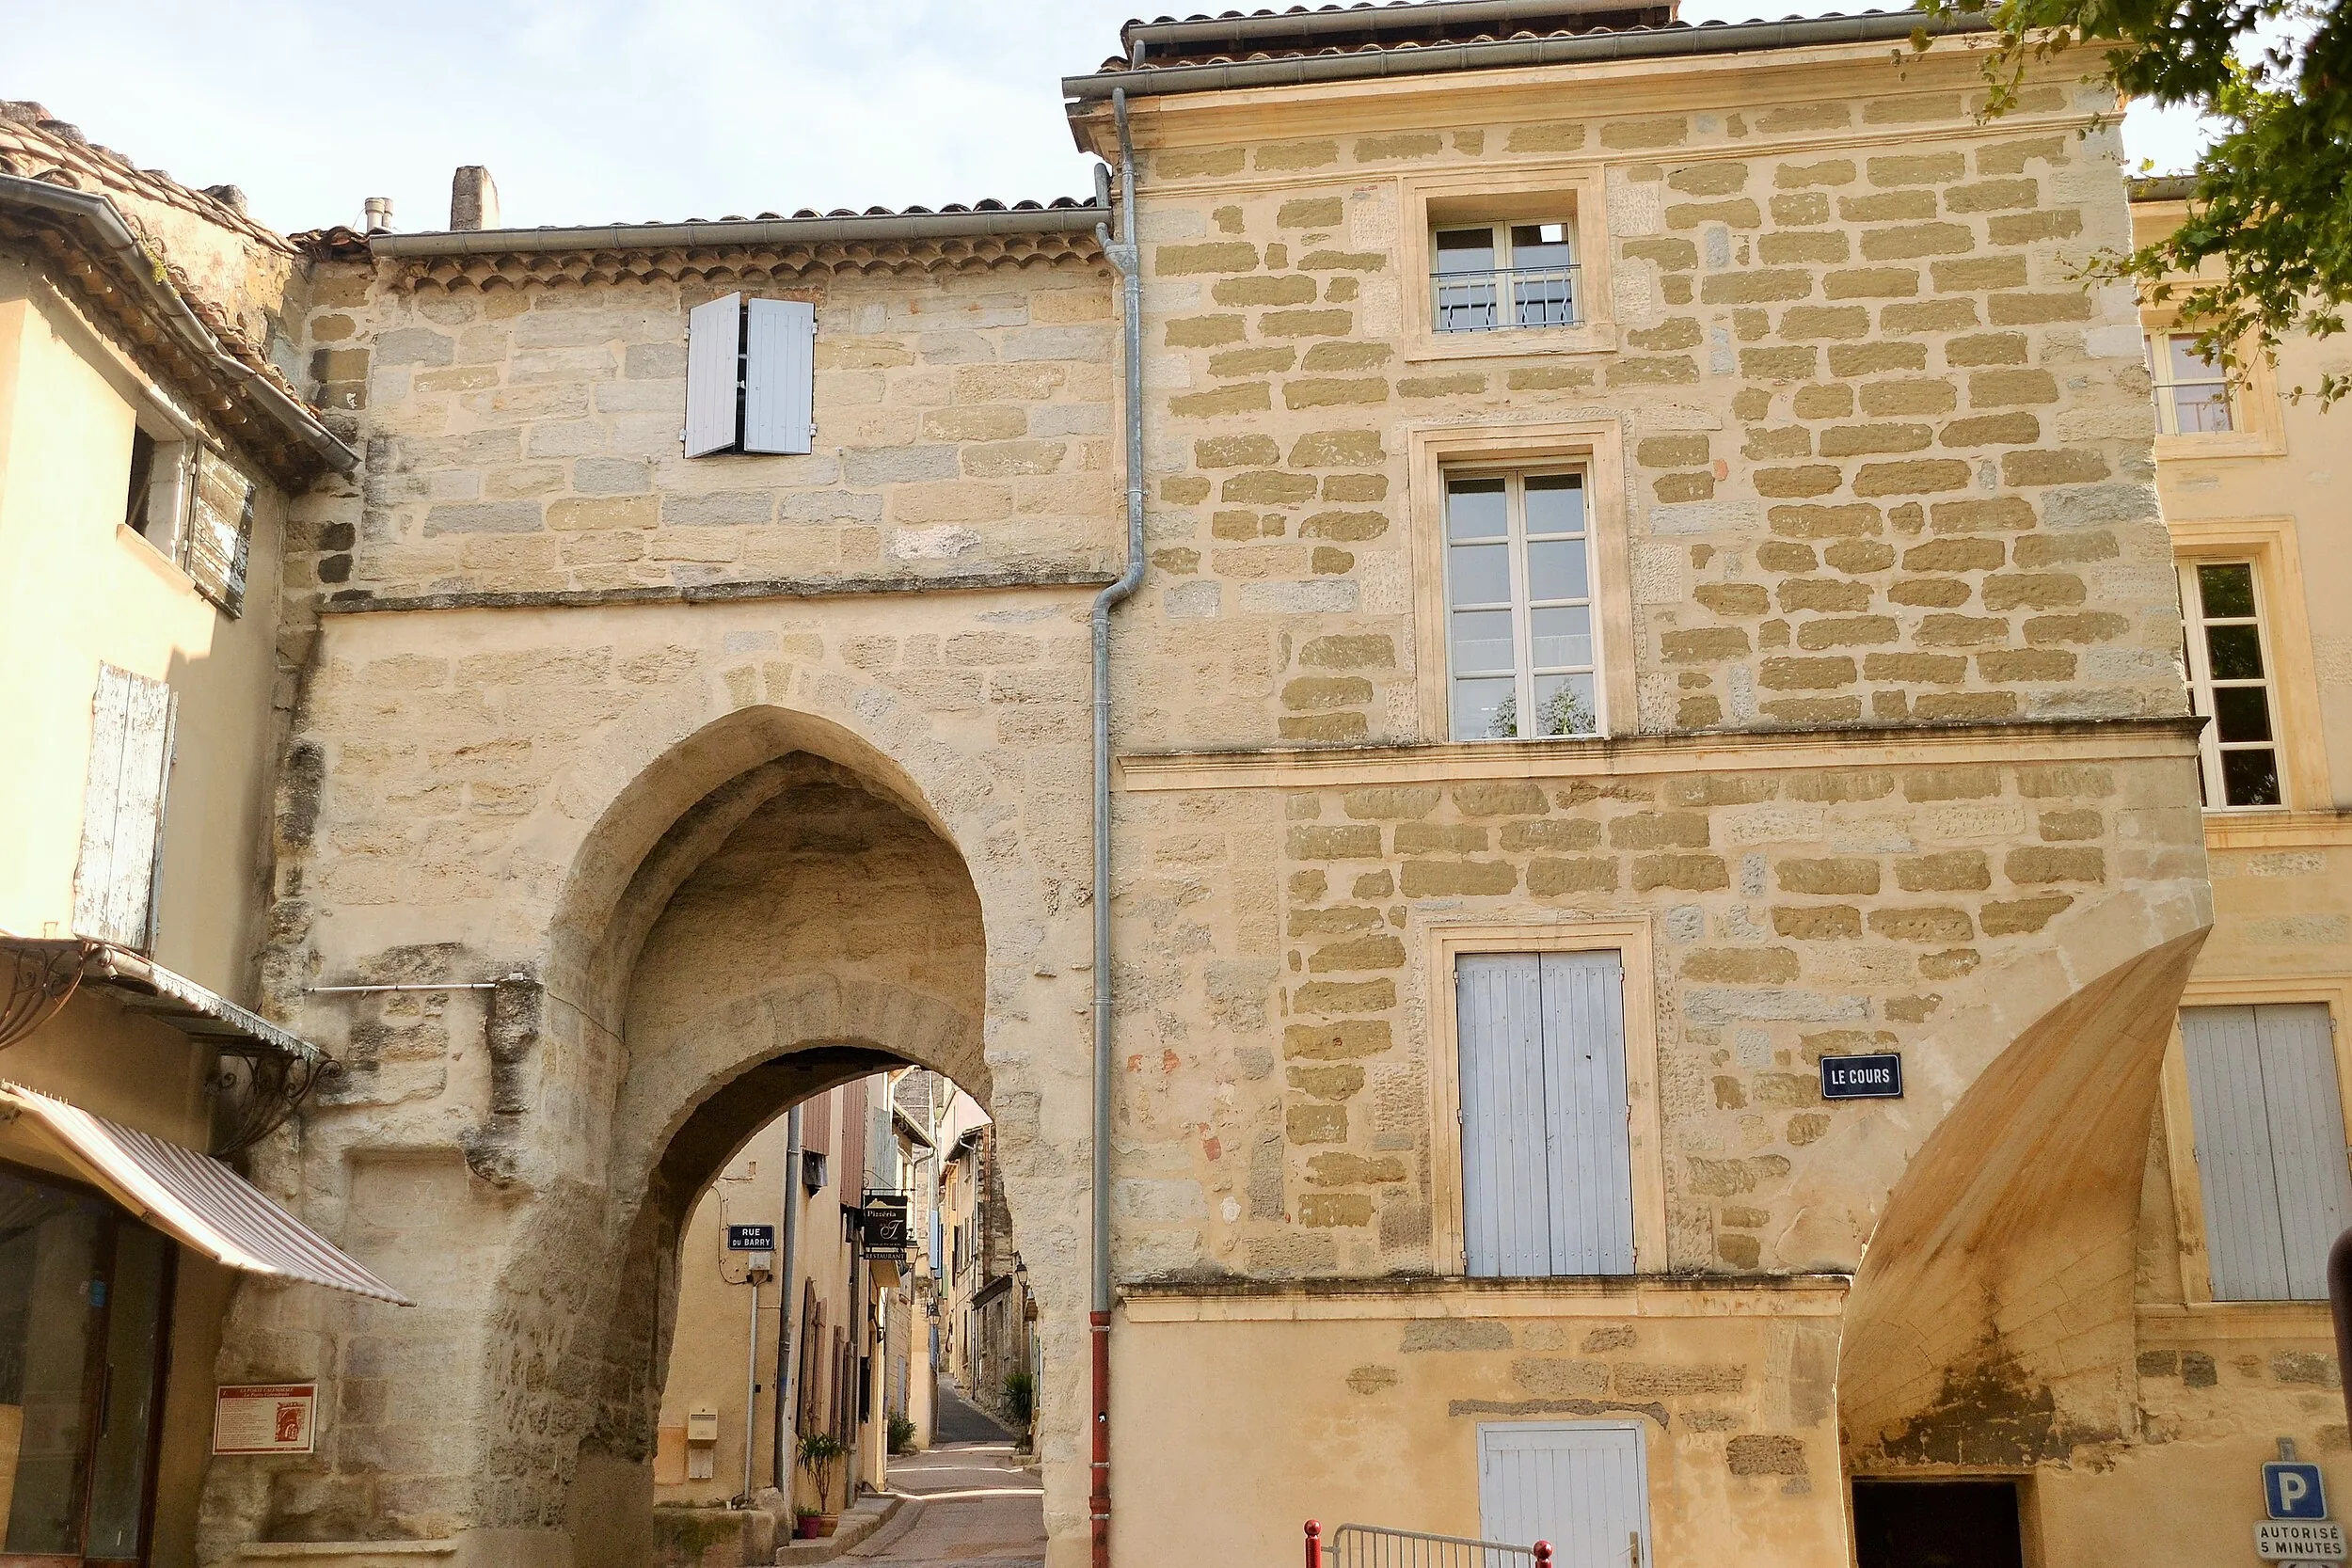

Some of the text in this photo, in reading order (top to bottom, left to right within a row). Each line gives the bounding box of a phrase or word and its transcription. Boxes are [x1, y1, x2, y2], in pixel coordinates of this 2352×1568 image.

[1832, 1068, 1890, 1085] LE COURS
[744, 1238, 771, 1246] BARRY
[2278, 1472, 2307, 1511] P
[2261, 1526, 2339, 1540] AUTORISÉ
[2261, 1542, 2342, 1554] 5 MINUTES
